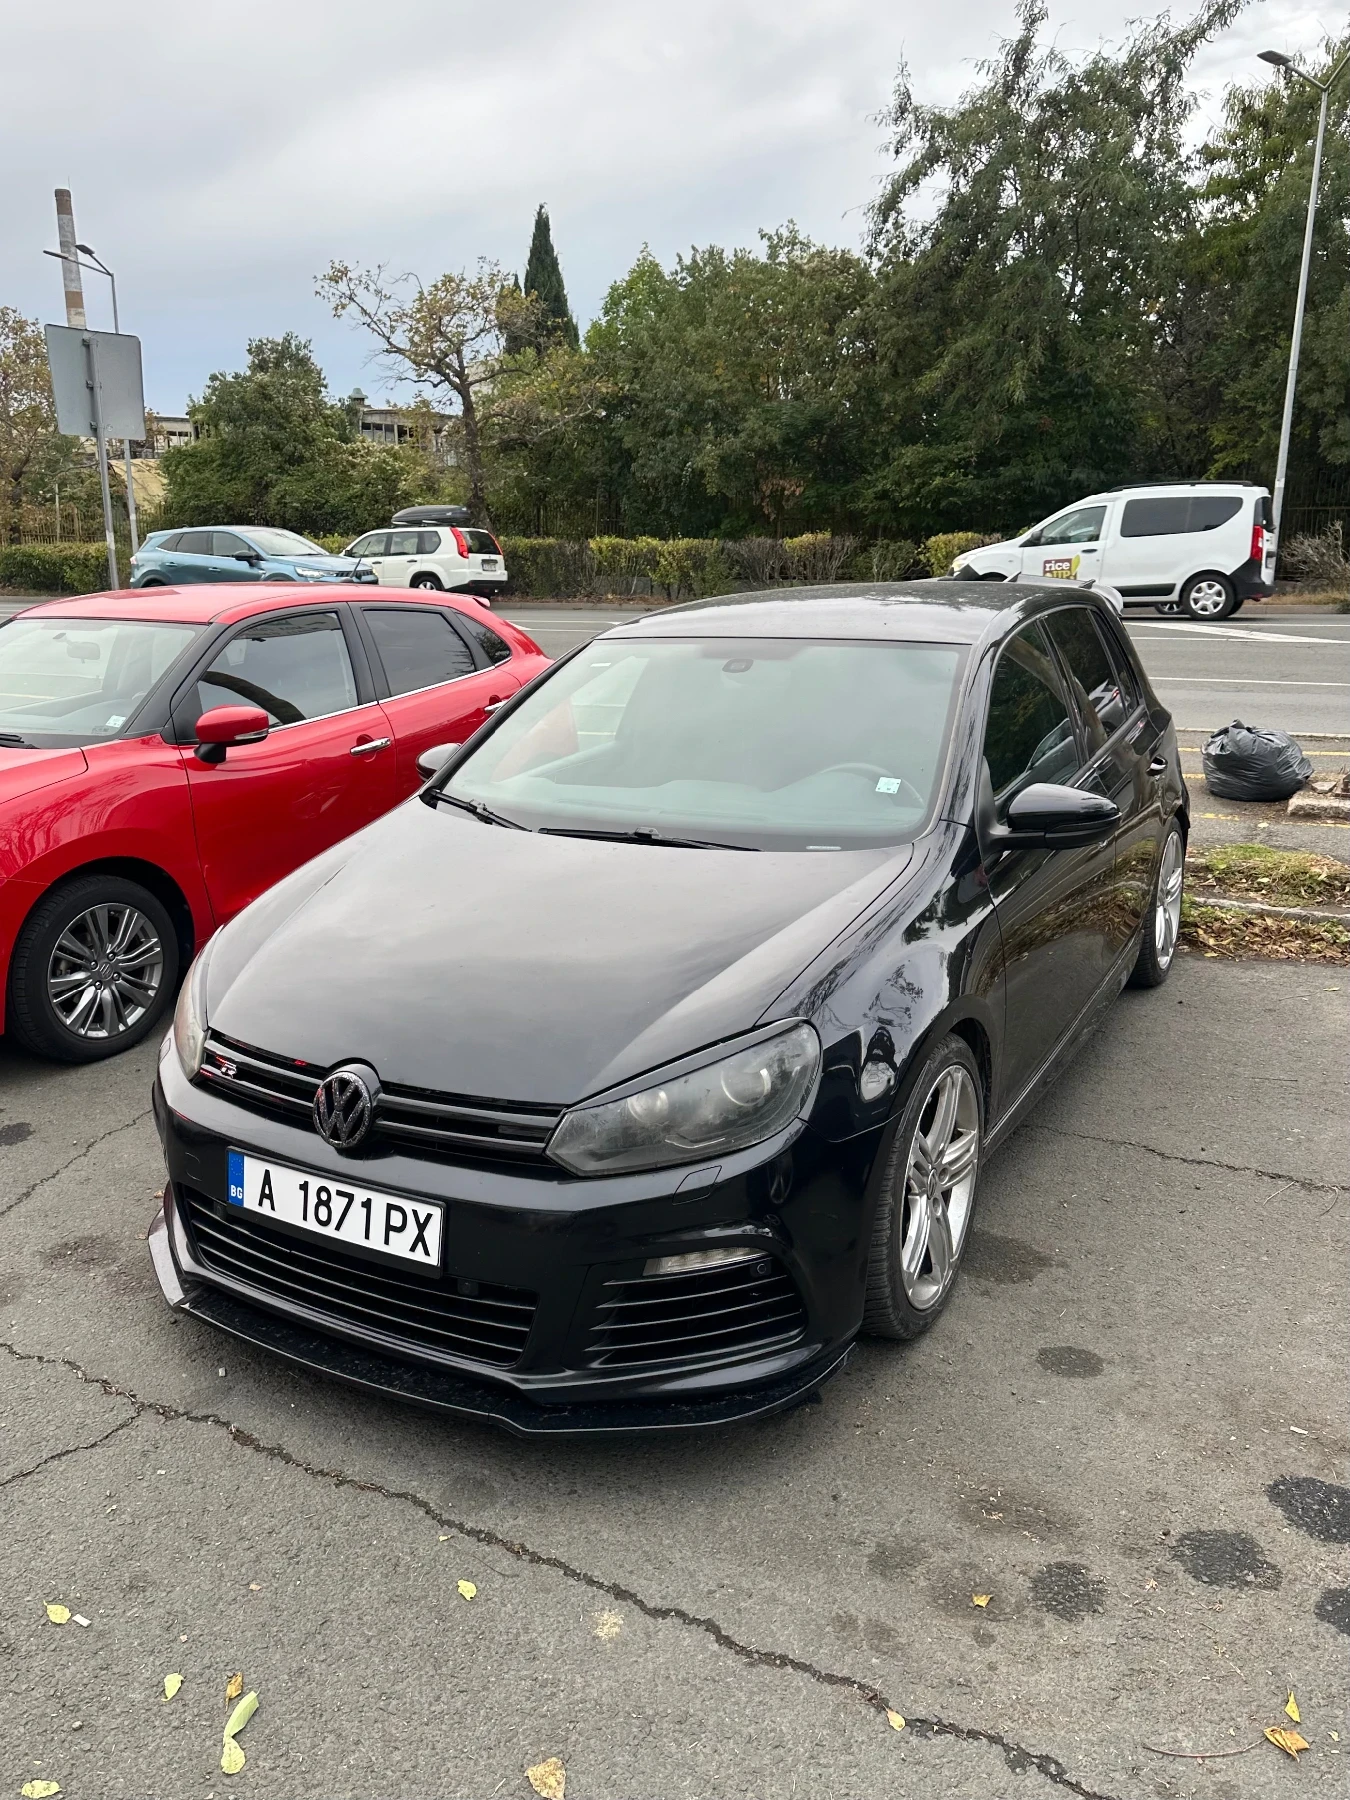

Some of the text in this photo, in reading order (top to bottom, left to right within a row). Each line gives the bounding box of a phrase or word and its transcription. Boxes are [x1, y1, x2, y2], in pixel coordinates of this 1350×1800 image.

[1045, 561, 1070, 571] rice
[230, 1184, 243, 1199] BG
[258, 1169, 276, 1211] A
